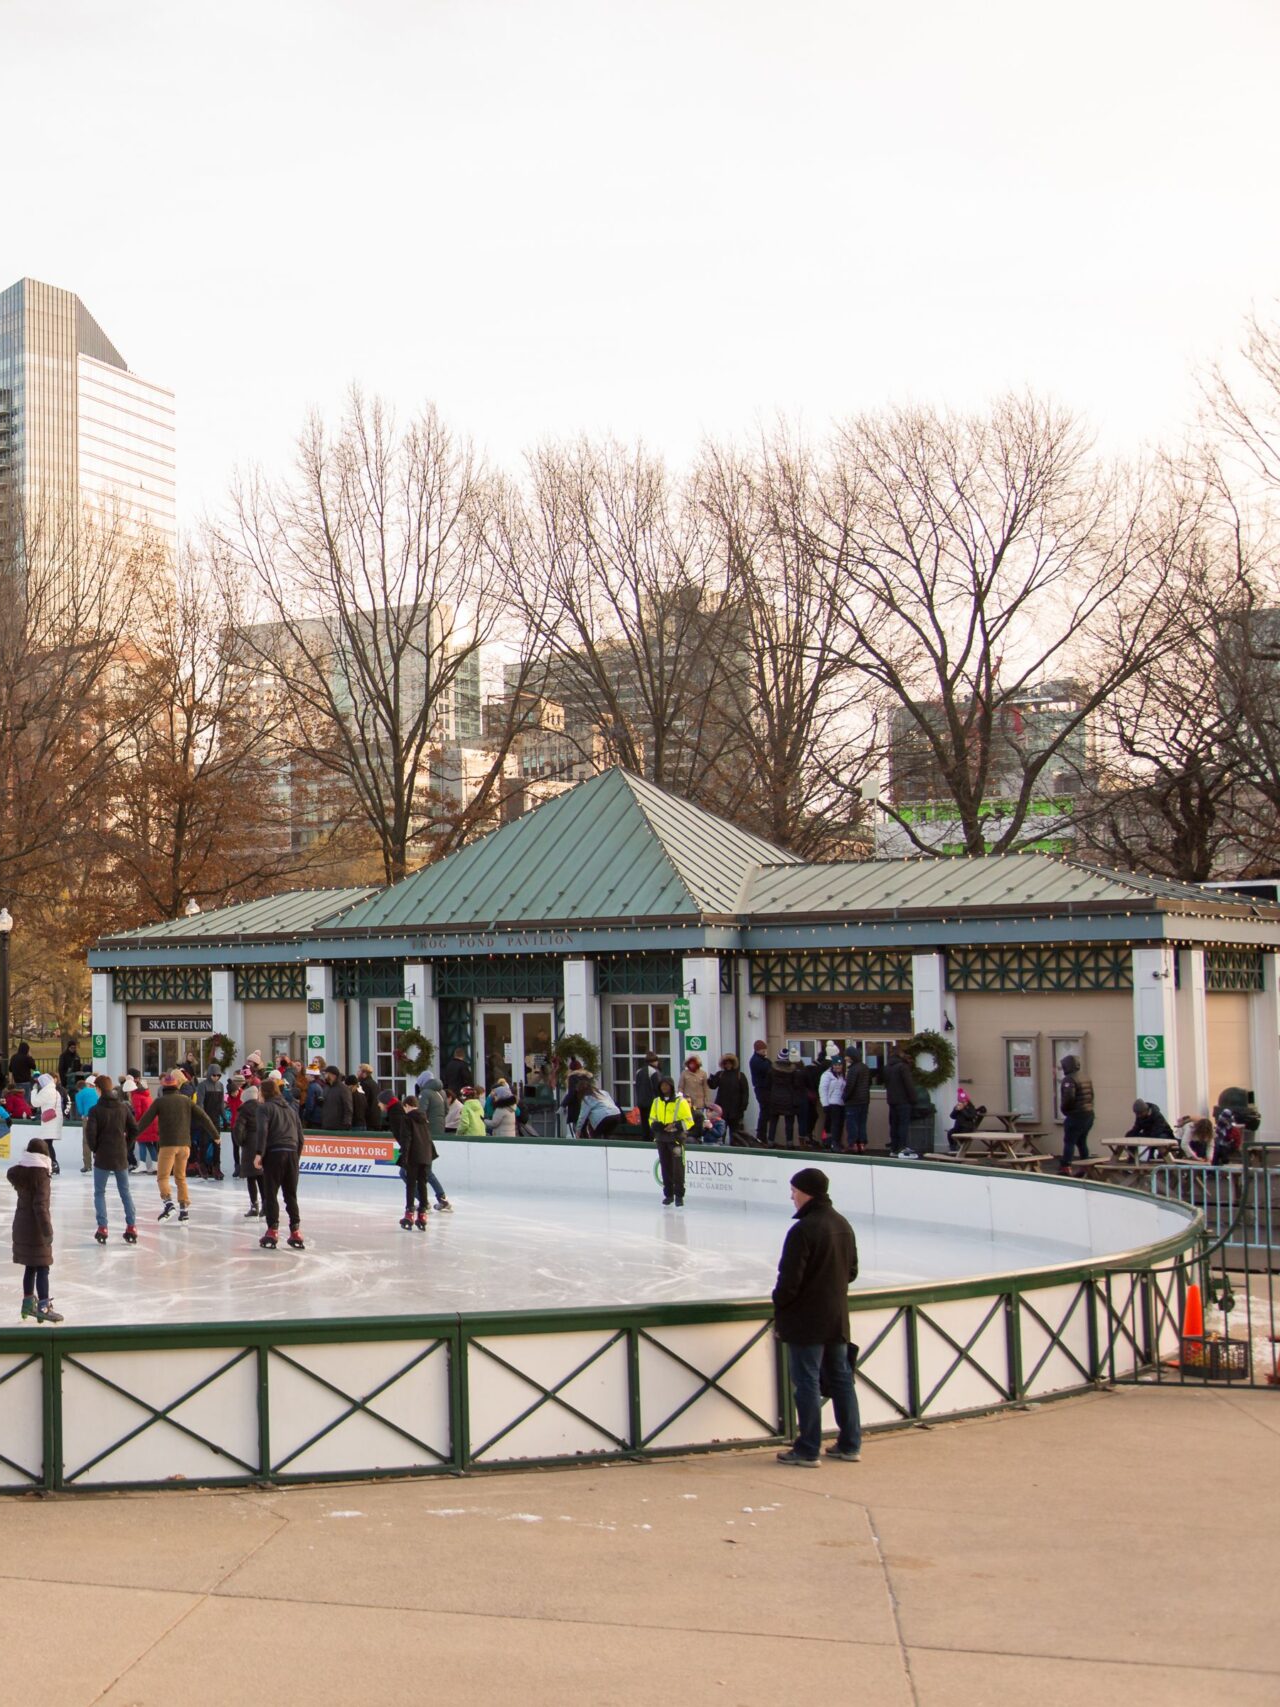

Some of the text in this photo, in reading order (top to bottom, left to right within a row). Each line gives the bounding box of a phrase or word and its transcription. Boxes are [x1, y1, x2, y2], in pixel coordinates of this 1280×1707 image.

[411, 934, 574, 950] FROG POND PAVILION
[310, 1001, 321, 1011] 38
[149, 1020, 212, 1030] SKATE RETURN
[302, 1143, 387, 1157] INGACADEMY.ORG
[300, 1161, 372, 1174] EARN TO SKATE!
[687, 1159, 734, 1177] RIENDS
[705, 1183, 734, 1191] GARDEN
